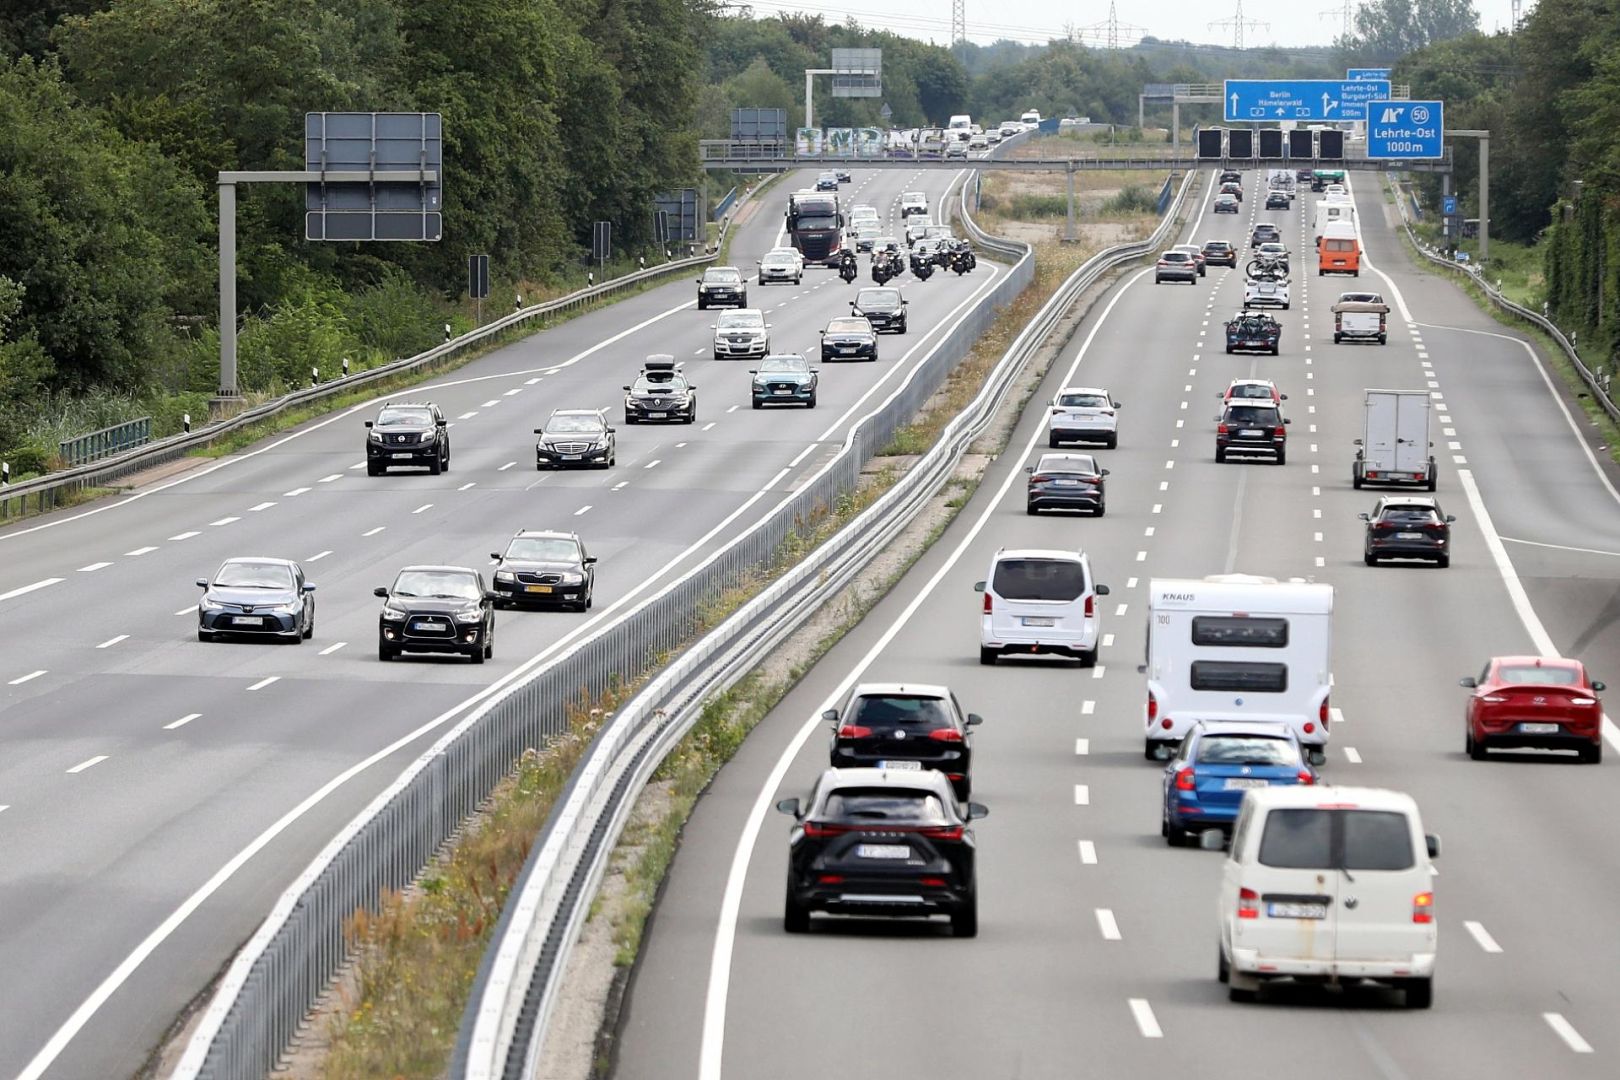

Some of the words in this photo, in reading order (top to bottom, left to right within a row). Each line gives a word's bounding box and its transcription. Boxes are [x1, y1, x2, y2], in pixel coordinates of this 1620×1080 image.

[1341, 92, 1387, 101] Burgdorf-Süd
[1413, 109, 1427, 120] 50
[1374, 127, 1436, 138] Lehrte-Ost
[1162, 593, 1195, 601] KNAUS
[1157, 614, 1170, 625] 100
